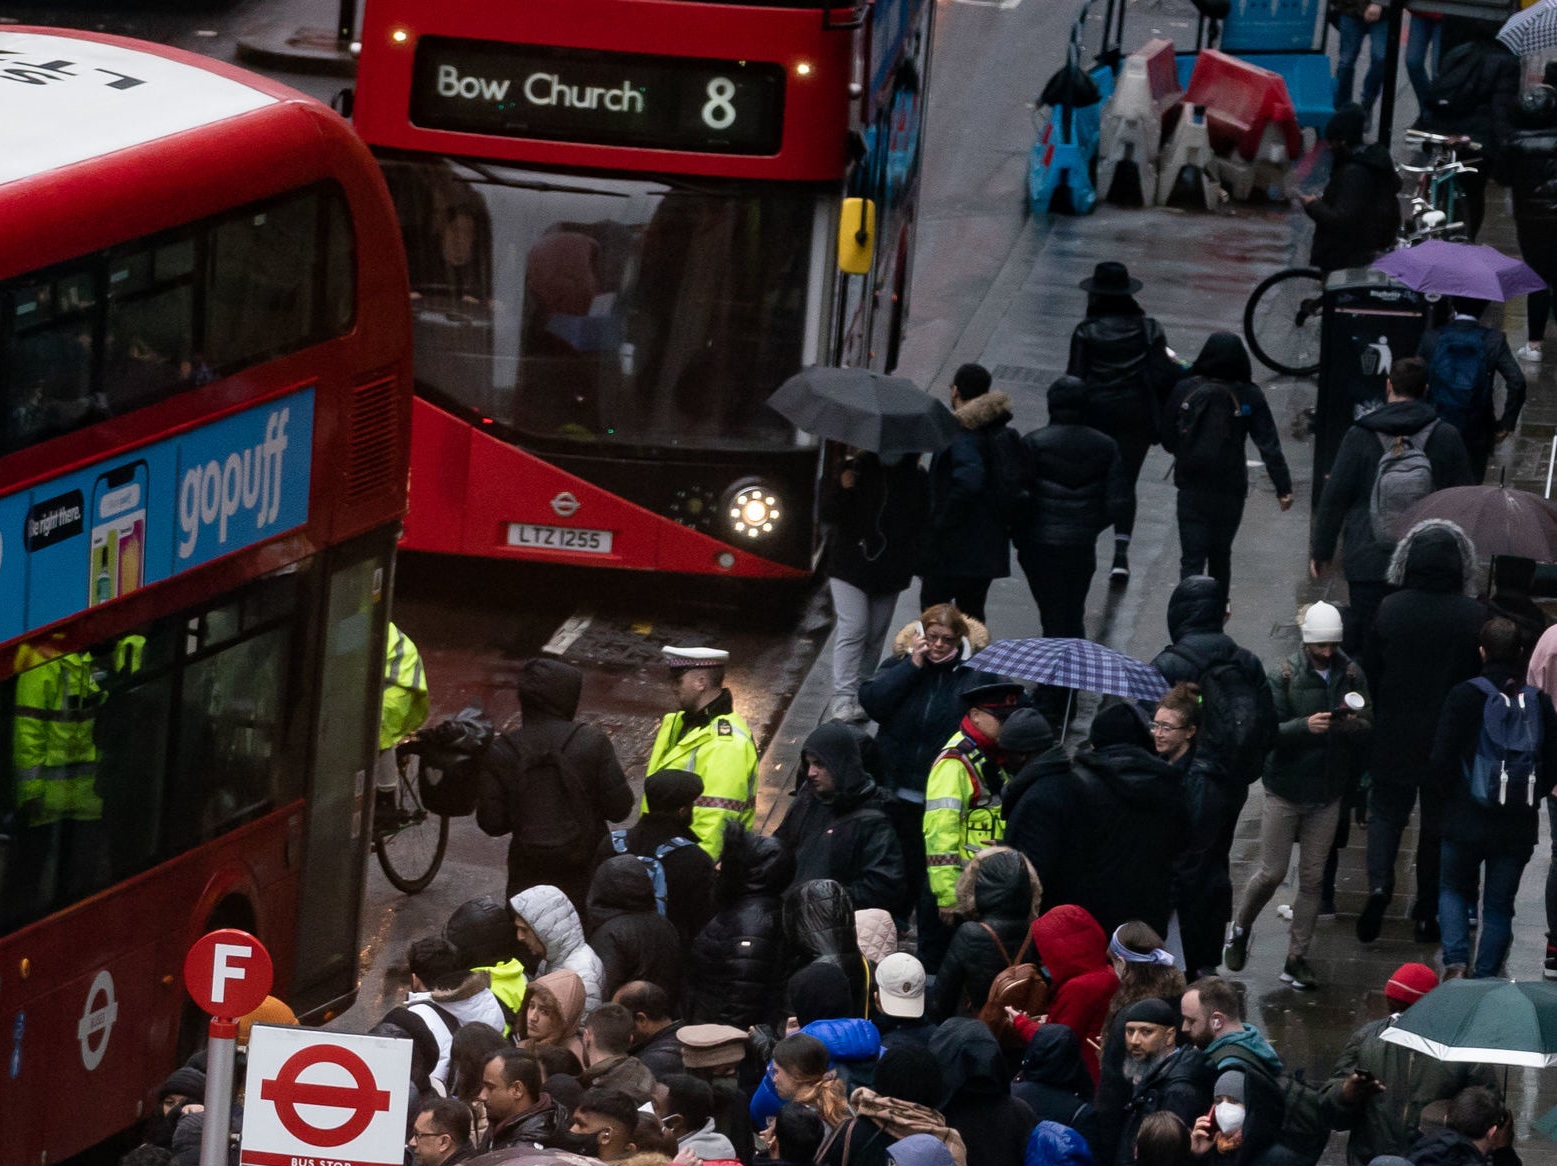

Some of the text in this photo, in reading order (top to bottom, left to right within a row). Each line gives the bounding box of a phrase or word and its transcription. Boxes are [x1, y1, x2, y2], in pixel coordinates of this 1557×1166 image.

[437, 64, 737, 130] Bow Church 8
[178, 406, 290, 560] gopuff
[210, 942, 253, 1004] F
